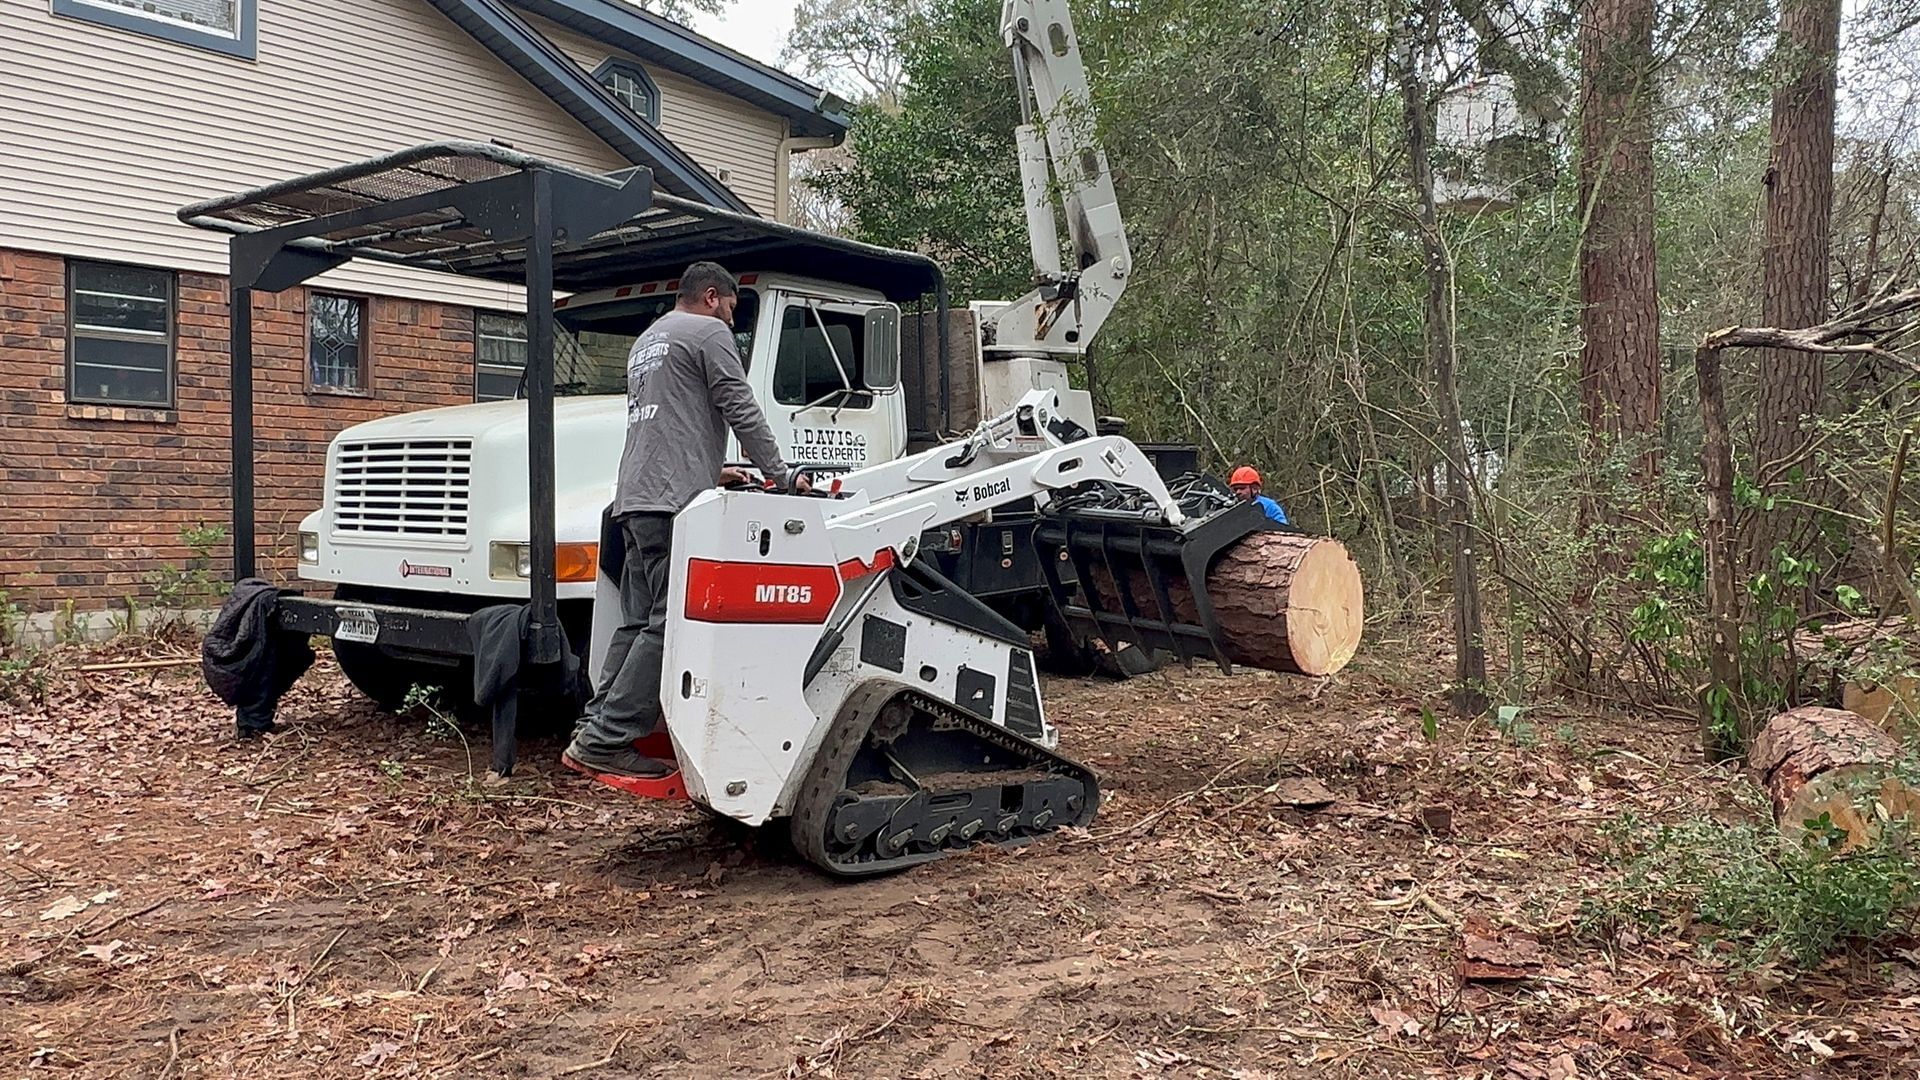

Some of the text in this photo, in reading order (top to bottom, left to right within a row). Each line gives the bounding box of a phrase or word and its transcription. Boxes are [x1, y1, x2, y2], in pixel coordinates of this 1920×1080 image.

[804, 429, 853, 446] DAVIS
[791, 446, 866, 461] TREE EXPERTS
[973, 477, 1011, 502] Bobcat
[755, 584, 812, 604] MT85
[348, 610, 365, 618] TEXAS
